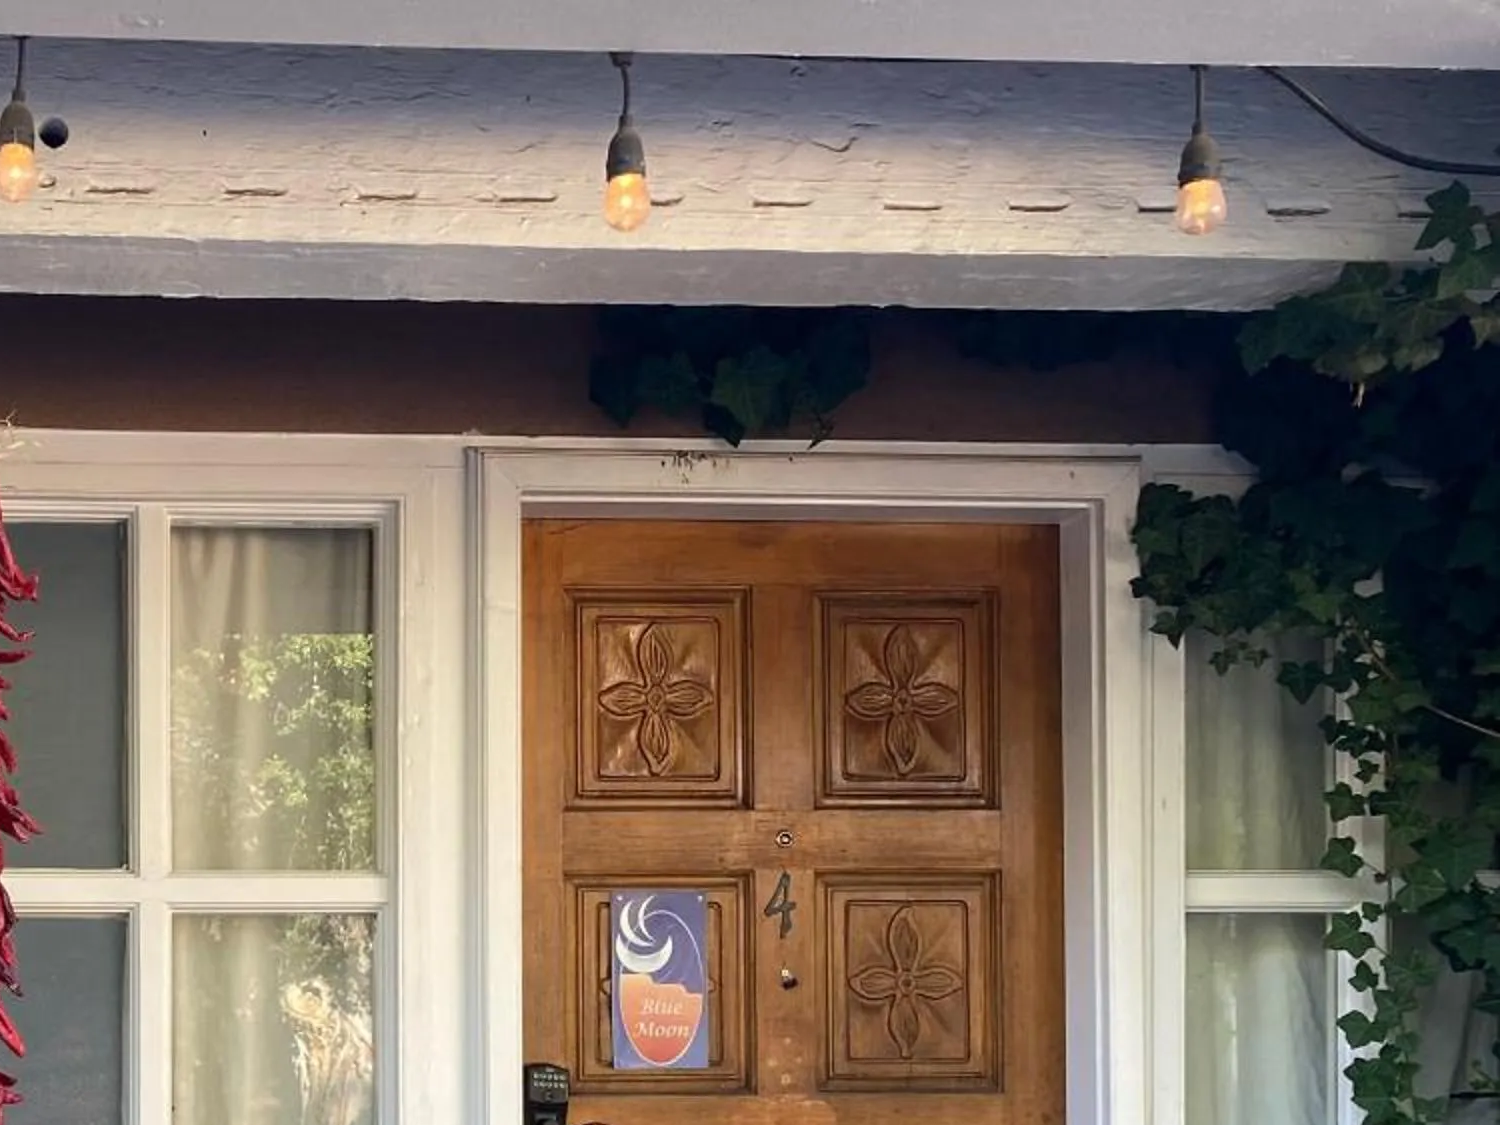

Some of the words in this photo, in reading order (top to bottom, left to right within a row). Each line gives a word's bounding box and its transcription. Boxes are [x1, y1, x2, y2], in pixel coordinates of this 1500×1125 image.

[764, 871, 797, 939] 4
[640, 998, 684, 1016] Blue
[635, 1021, 690, 1038] Moon
